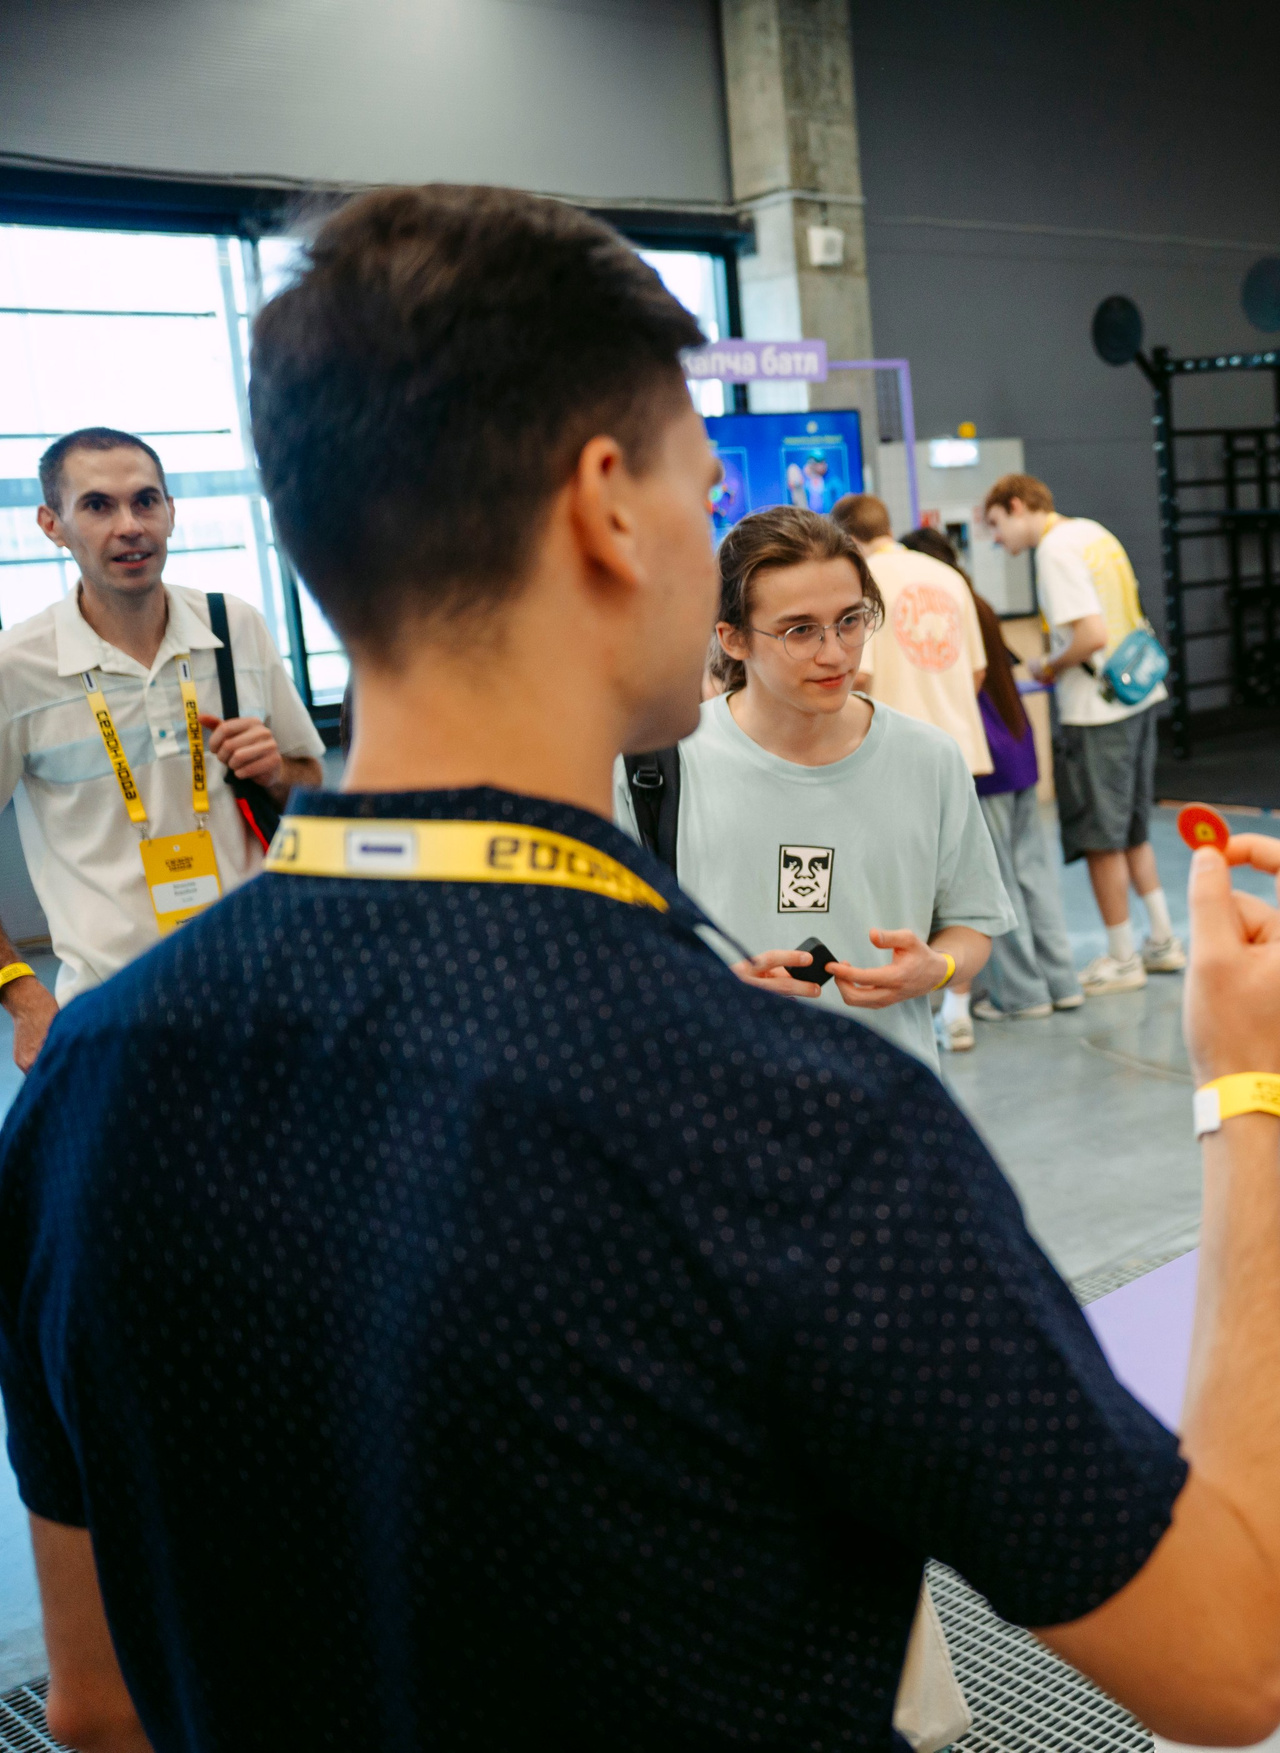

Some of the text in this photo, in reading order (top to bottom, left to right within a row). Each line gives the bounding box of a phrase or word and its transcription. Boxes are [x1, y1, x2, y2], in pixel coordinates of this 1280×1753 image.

[760, 346, 819, 376] батл
[95, 709, 137, 801] сезон кода
